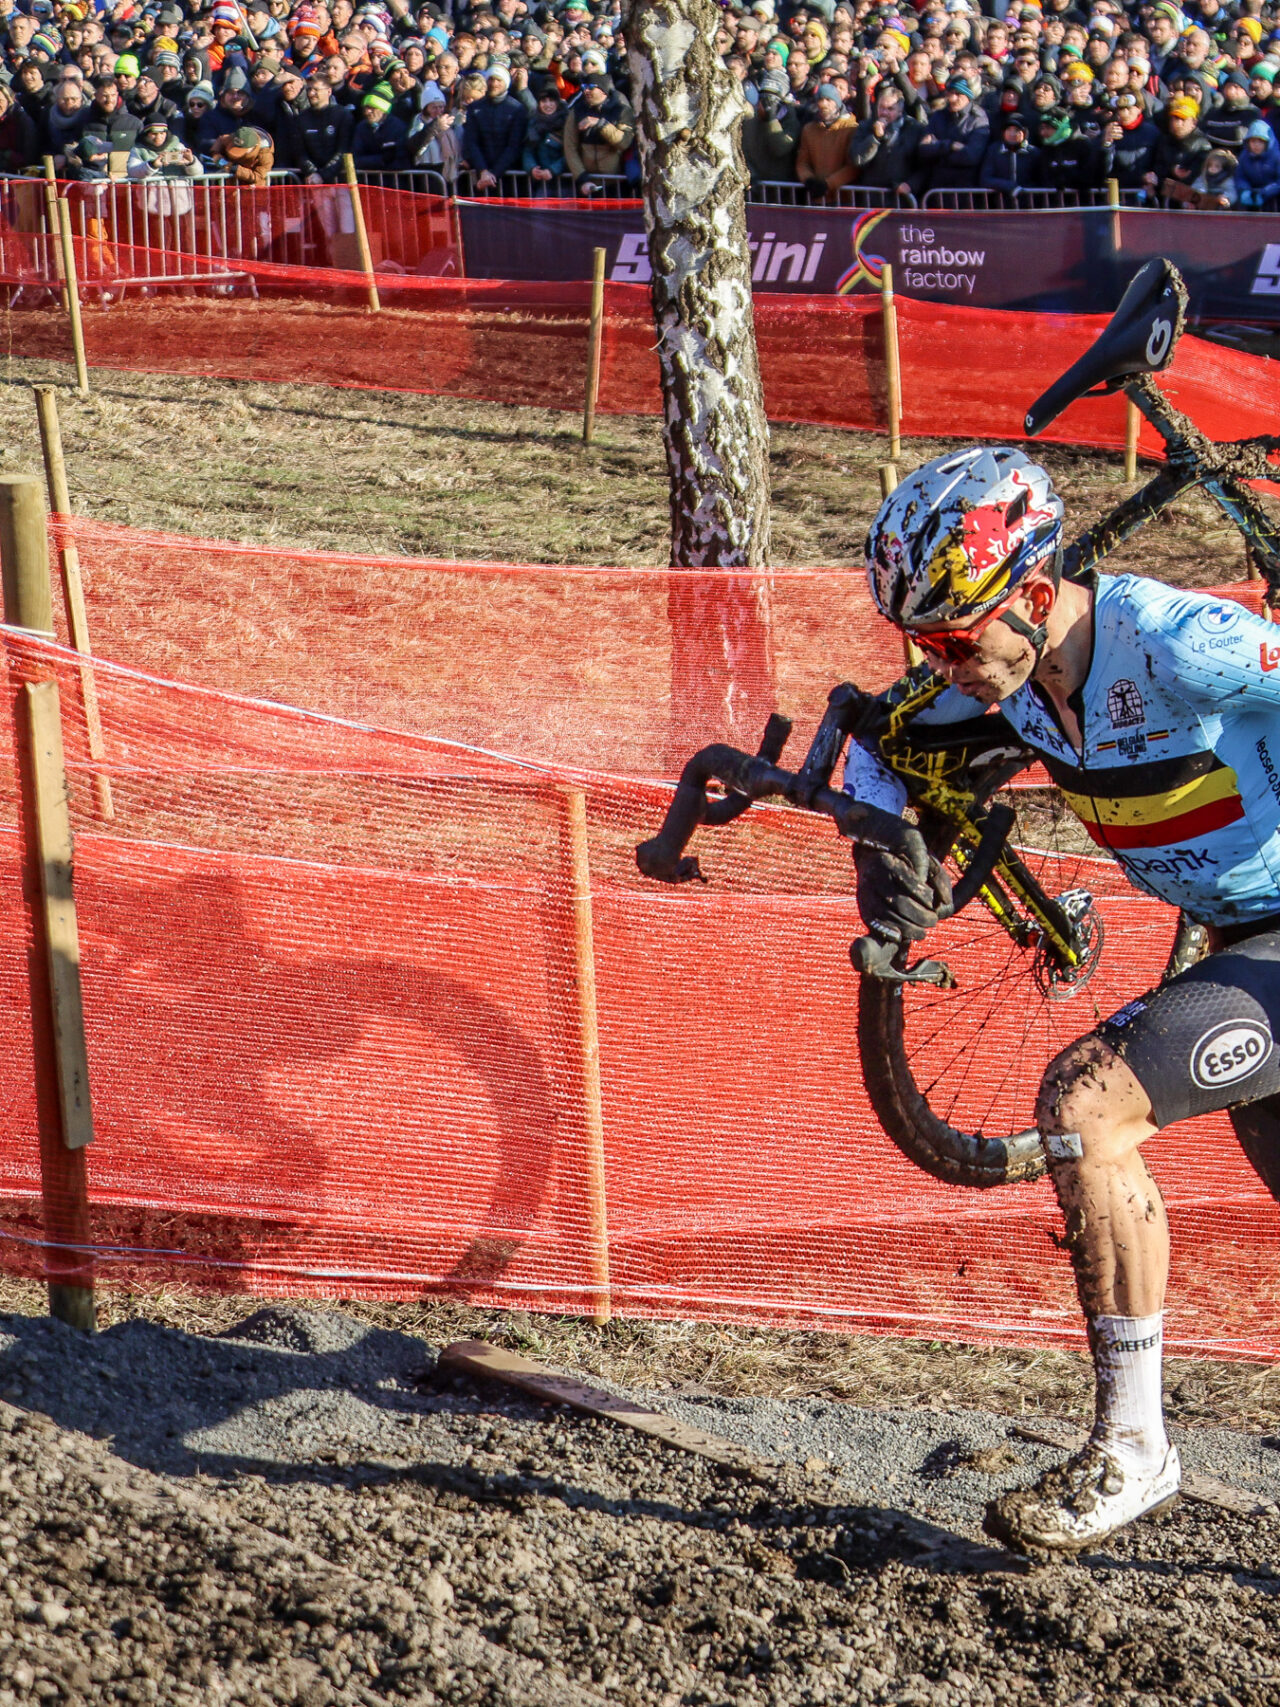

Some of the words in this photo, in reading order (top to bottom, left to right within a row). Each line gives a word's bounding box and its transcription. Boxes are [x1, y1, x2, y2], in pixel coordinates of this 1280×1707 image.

[899, 224, 935, 244] the
[611, 232, 828, 283] Sini
[901, 246, 985, 266] rainbow
[904, 268, 976, 294] factory
